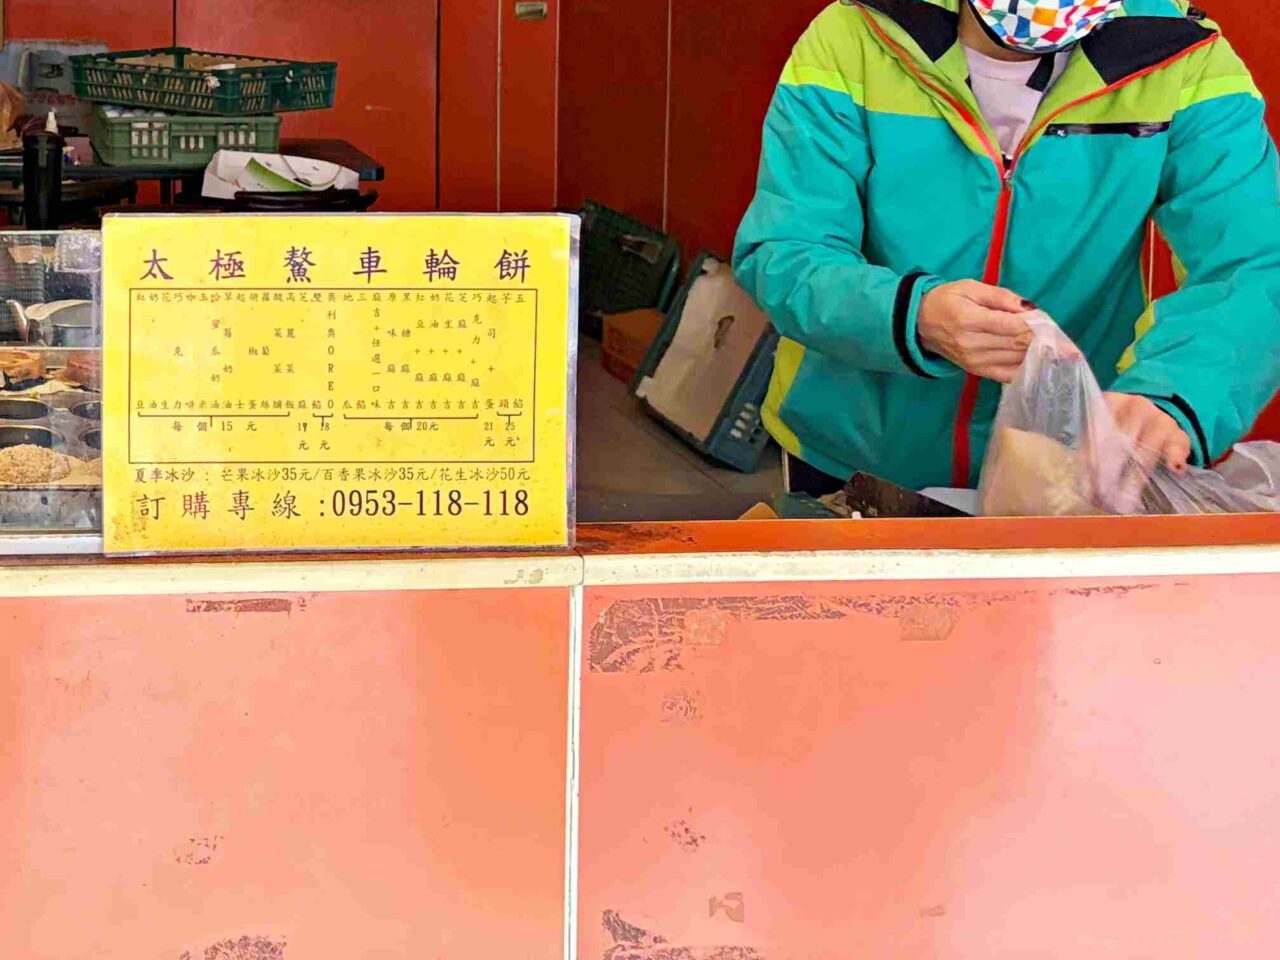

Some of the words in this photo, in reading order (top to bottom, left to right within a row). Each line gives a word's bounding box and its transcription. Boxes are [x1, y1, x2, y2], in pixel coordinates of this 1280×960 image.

[139, 246, 531, 284] 太極鰲車輪餅
